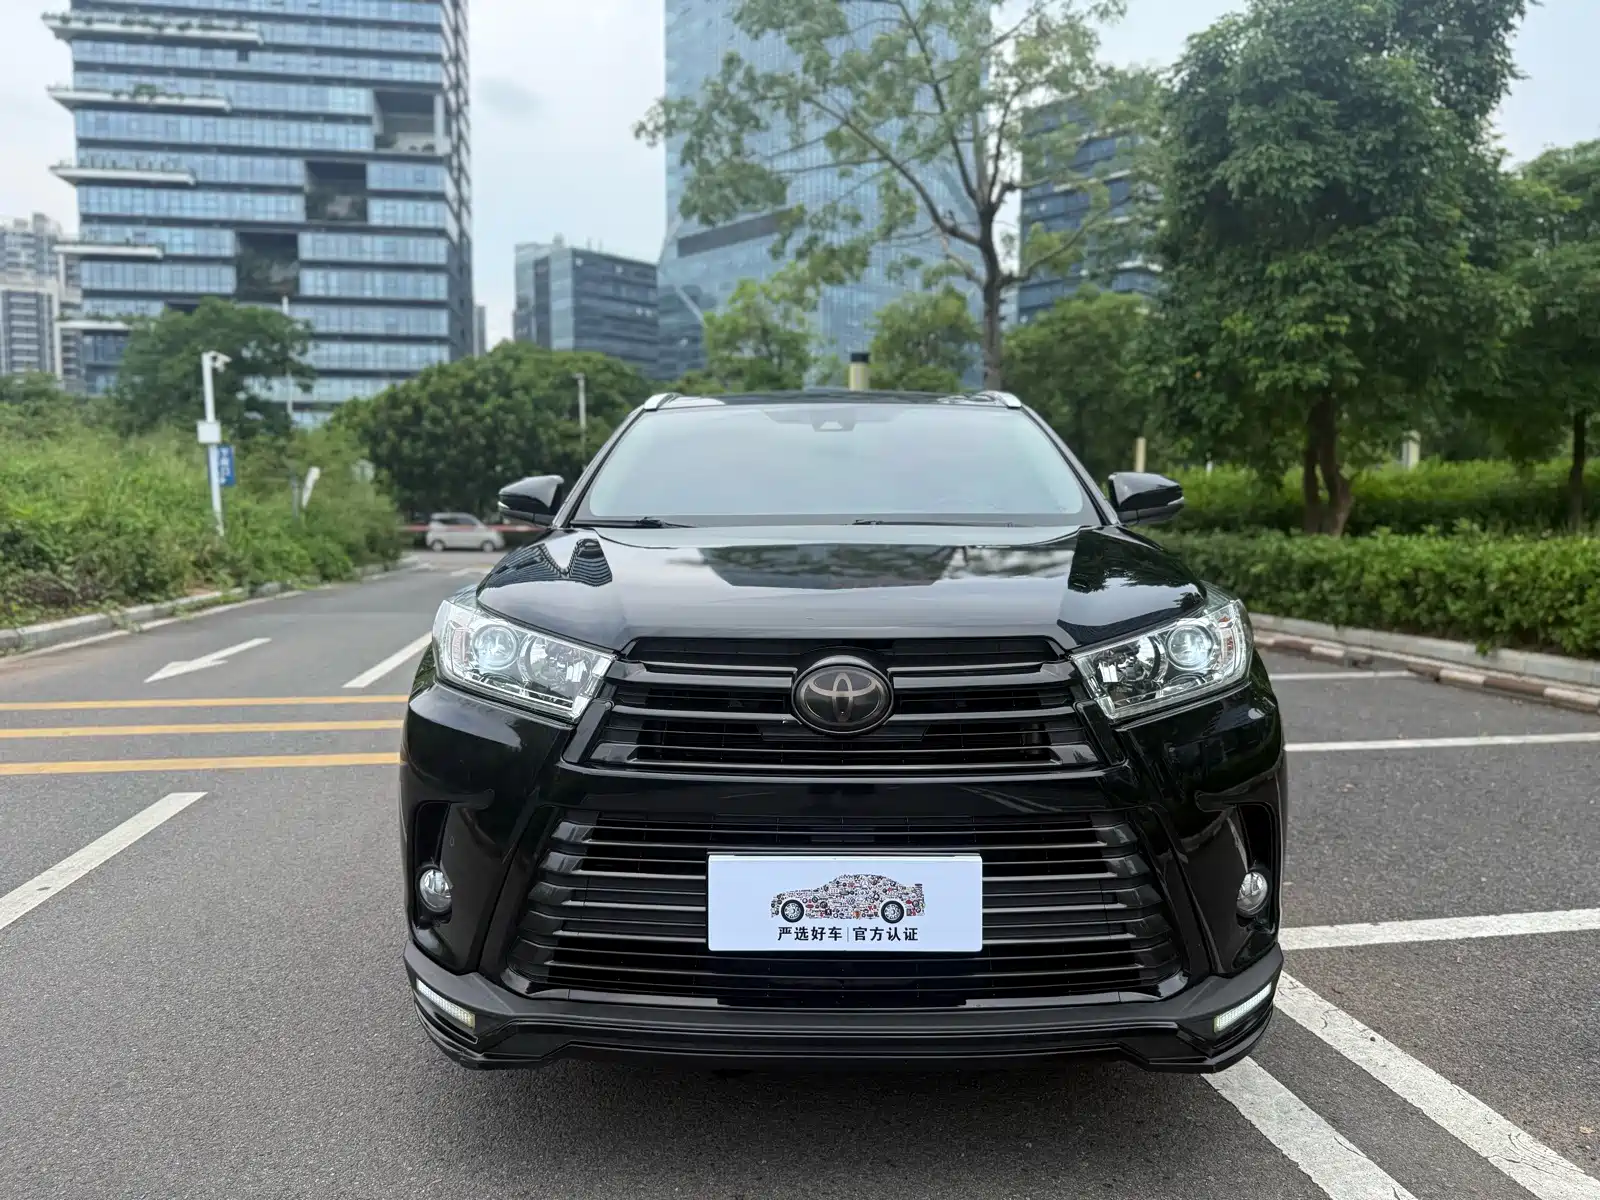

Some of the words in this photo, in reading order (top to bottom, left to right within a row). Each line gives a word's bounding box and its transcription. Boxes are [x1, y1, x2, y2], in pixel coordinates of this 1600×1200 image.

[777, 926, 843, 941] 严选好车
[853, 926, 919, 941] 官方认证
